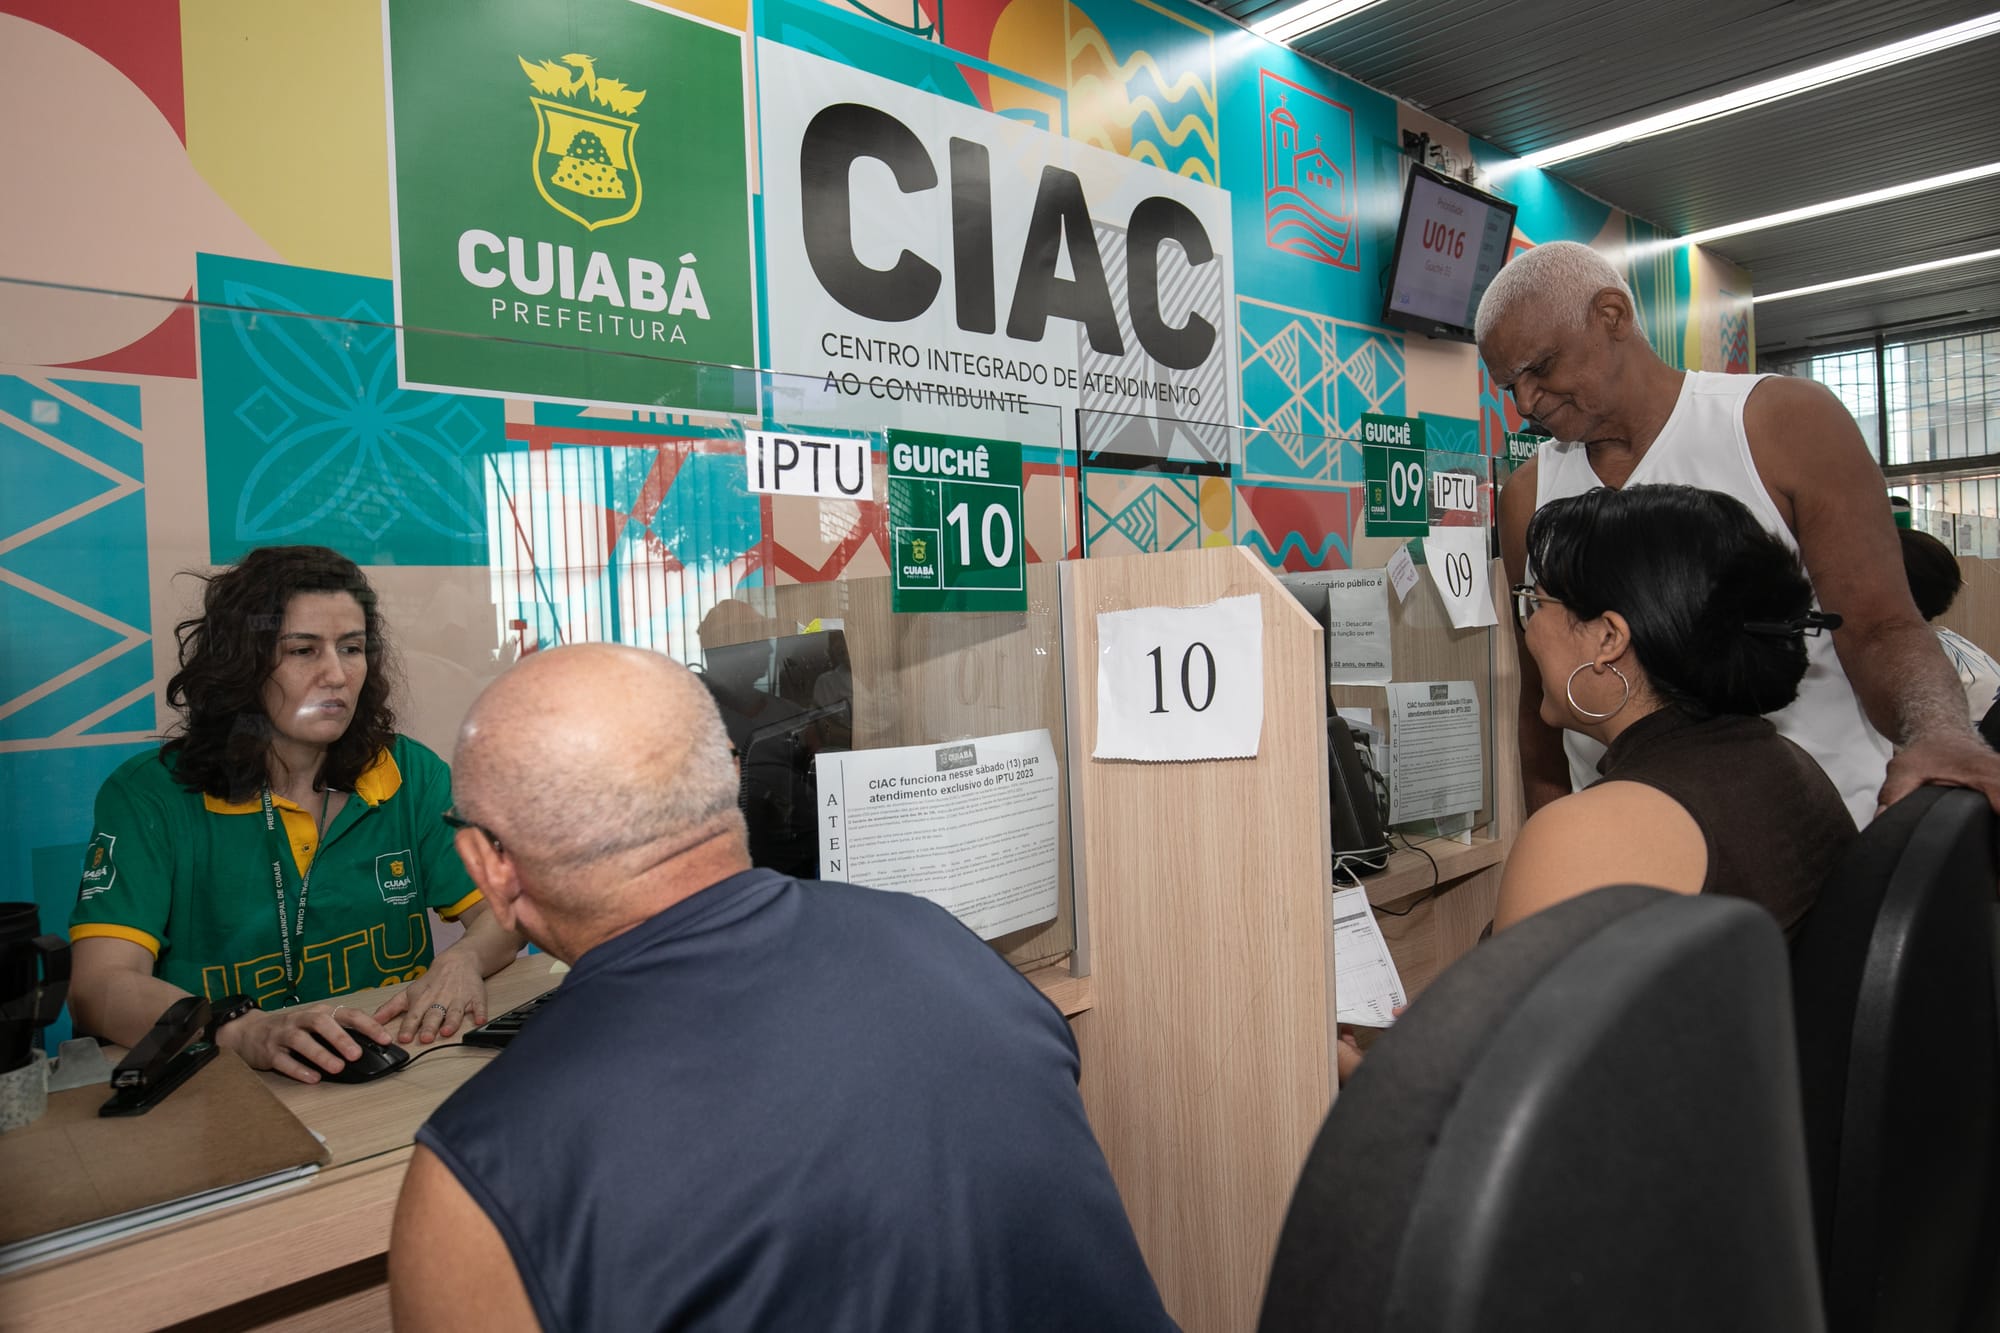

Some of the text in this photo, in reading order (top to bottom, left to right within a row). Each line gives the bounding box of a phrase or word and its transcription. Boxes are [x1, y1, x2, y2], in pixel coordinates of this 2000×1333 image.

[800, 103, 1216, 371] CIAC
[1423, 219, 1466, 259] U016
[458, 229, 711, 320] CUIABÁ
[492, 299, 687, 345] PREFEITURA
[821, 333, 1201, 406] CENTRO INTEGRADO DE ATENDIMENTO
[823, 371, 1029, 415] AO CONTRIBUINTE
[1365, 422, 1411, 445] GUICHÊ
[1509, 440, 1538, 458] GUICH
[758, 437, 864, 495] IPTU
[893, 443, 989, 478] GUICHÊ
[1391, 461, 1424, 507] 09
[1436, 476, 1474, 510] IPTU
[946, 502, 1014, 567] 10
[903, 564, 934, 575] CUIABÁ
[1347, 579, 1376, 589] público
[1377, 578, 1382, 586] é
[1446, 552, 1473, 598] 09
[1146, 642, 1216, 713] 10
[868, 756, 1040, 789] CIAC funciona nesse sábado (13) para
[869, 769, 1034, 803] atendimento exclusivo do IPTU 2023
[826, 793, 841, 873] ATEN
[276, 889, 285, 899] DE
[202, 913, 427, 1004] IPTU
